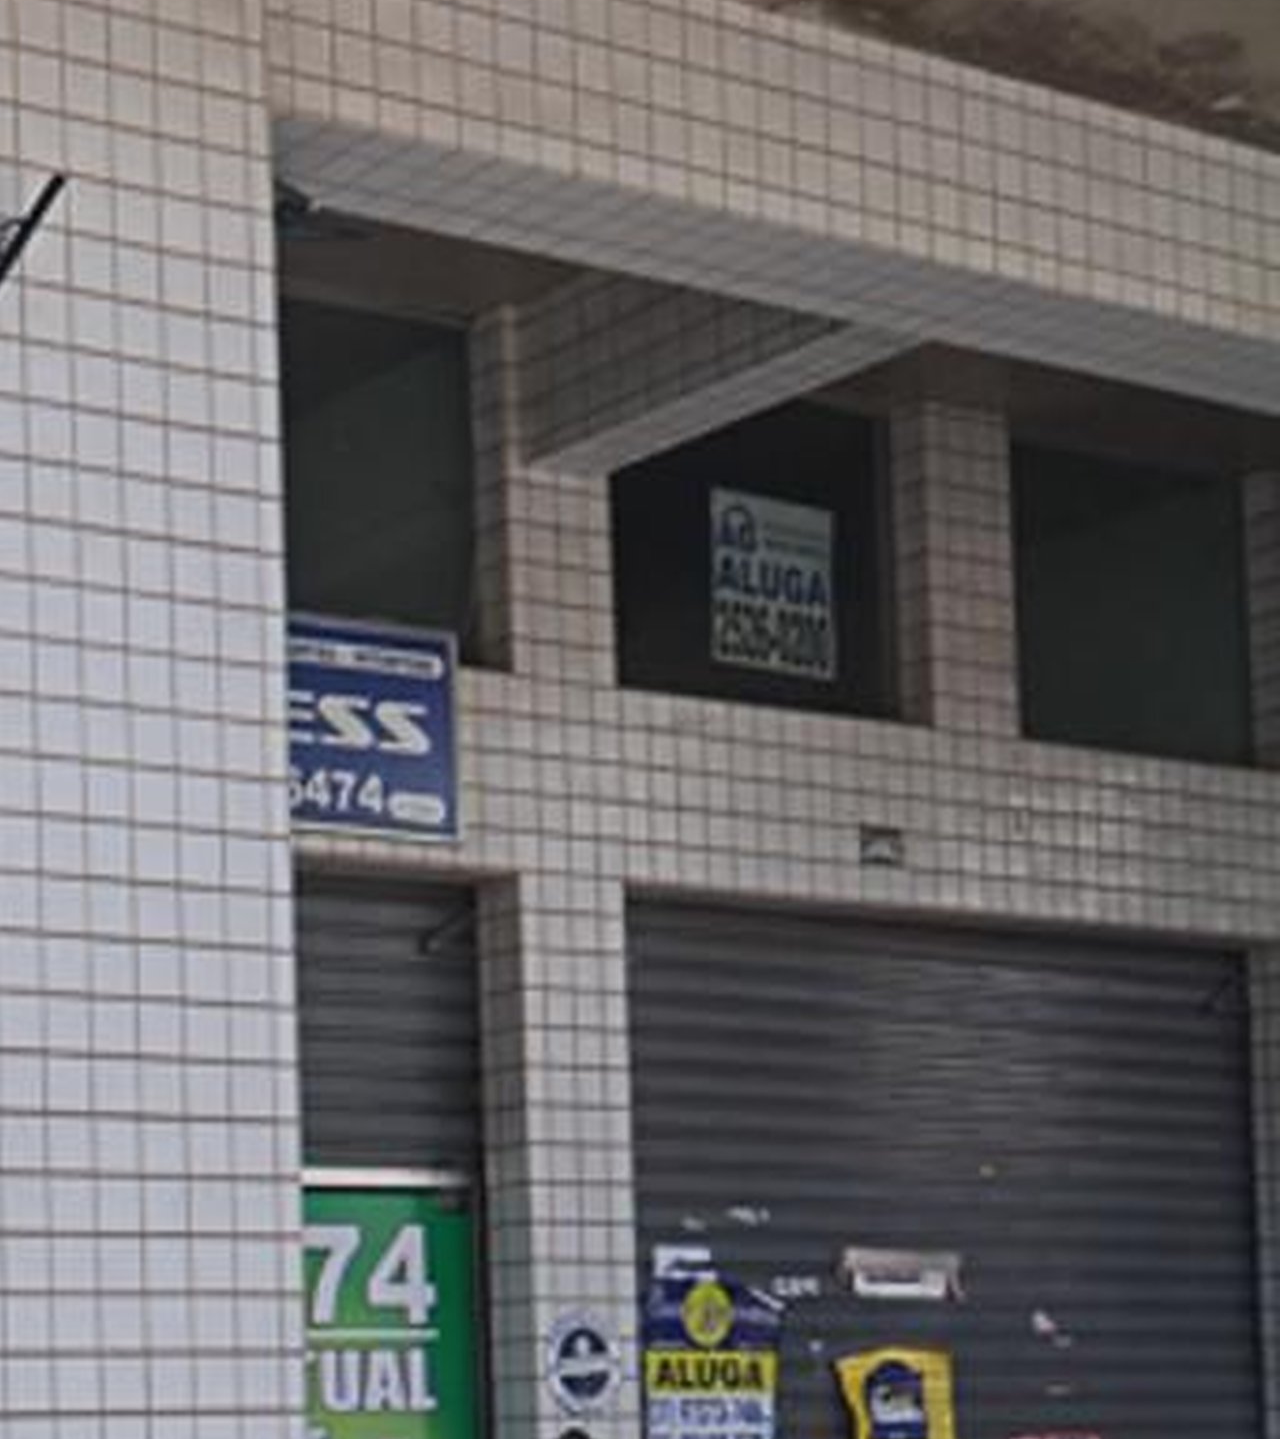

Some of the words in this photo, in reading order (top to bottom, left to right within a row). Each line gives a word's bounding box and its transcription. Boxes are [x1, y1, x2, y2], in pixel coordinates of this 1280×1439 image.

[302, 1223, 438, 1326] 74
[306, 1346, 438, 1412] UAL
[654, 1356, 765, 1392] ALUGA
